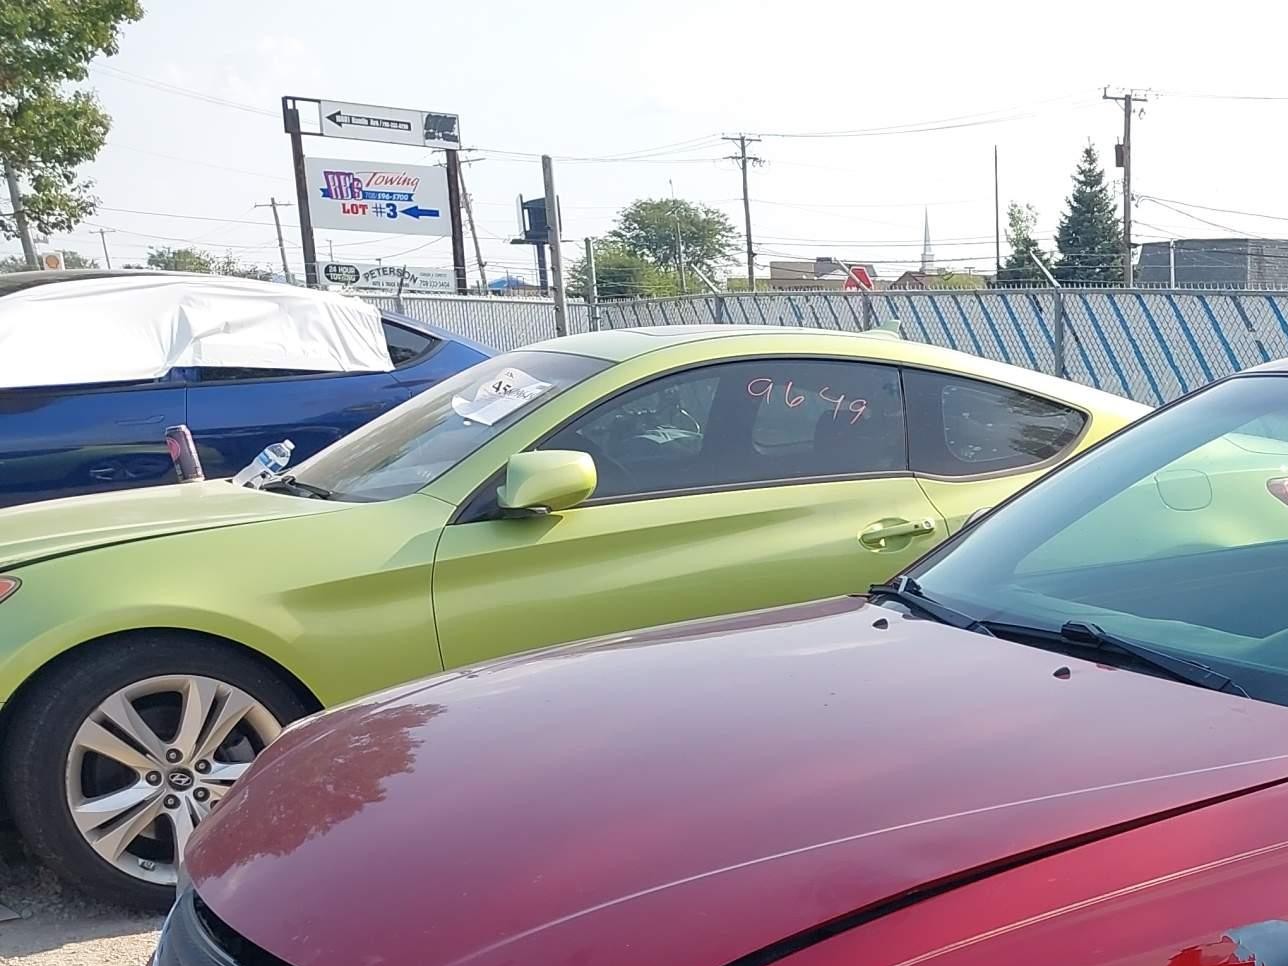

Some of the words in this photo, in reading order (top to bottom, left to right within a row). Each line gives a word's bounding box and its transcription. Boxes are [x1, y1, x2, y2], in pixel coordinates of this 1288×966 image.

[356, 172, 420, 193] Towing
[341, 203, 368, 215] LOT
[371, 202, 398, 219] #3
[338, 266, 356, 274] HOUR
[363, 267, 418, 285] PETERSON
